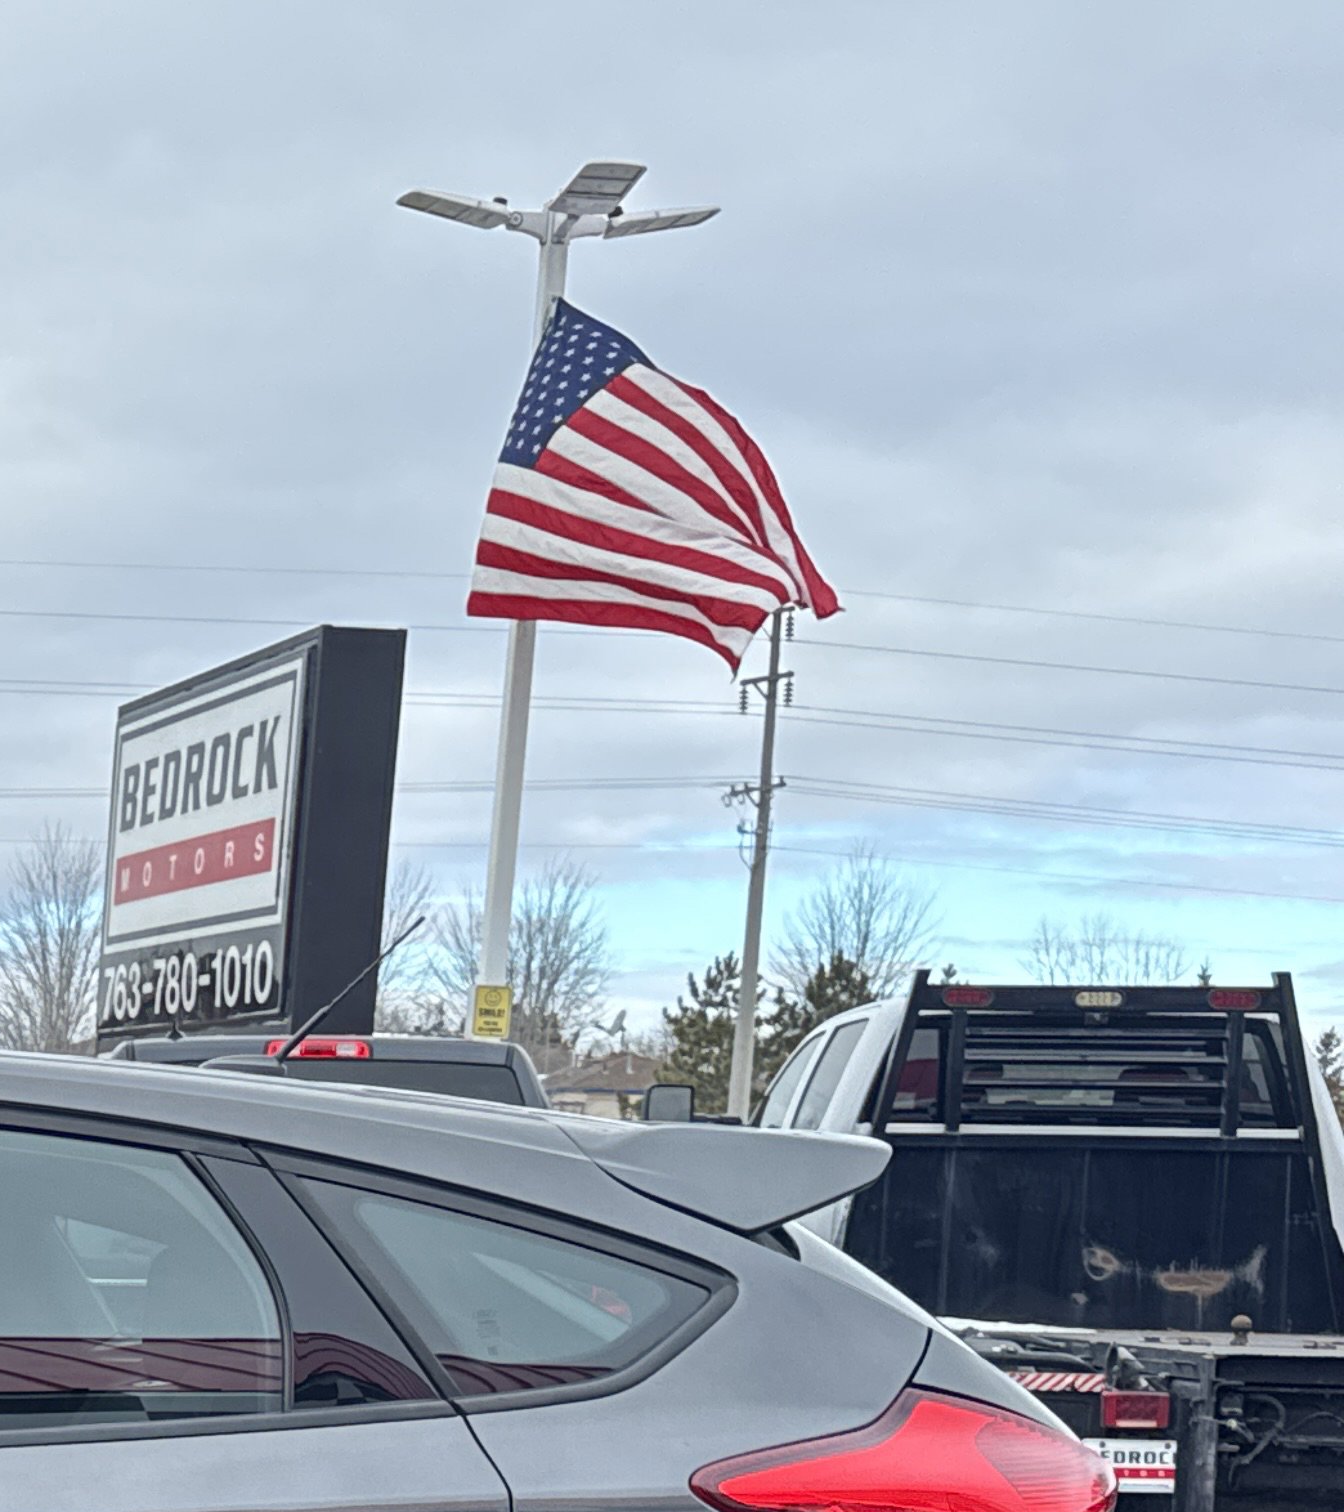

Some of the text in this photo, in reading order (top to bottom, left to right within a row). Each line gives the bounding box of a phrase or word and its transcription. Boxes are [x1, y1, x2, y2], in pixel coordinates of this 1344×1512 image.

[119, 715, 281, 833] BEDROCK
[120, 832, 266, 893] MOTORS
[103, 939, 275, 1022] 763-780-1010
[1100, 1449, 1177, 1465] EDROC
